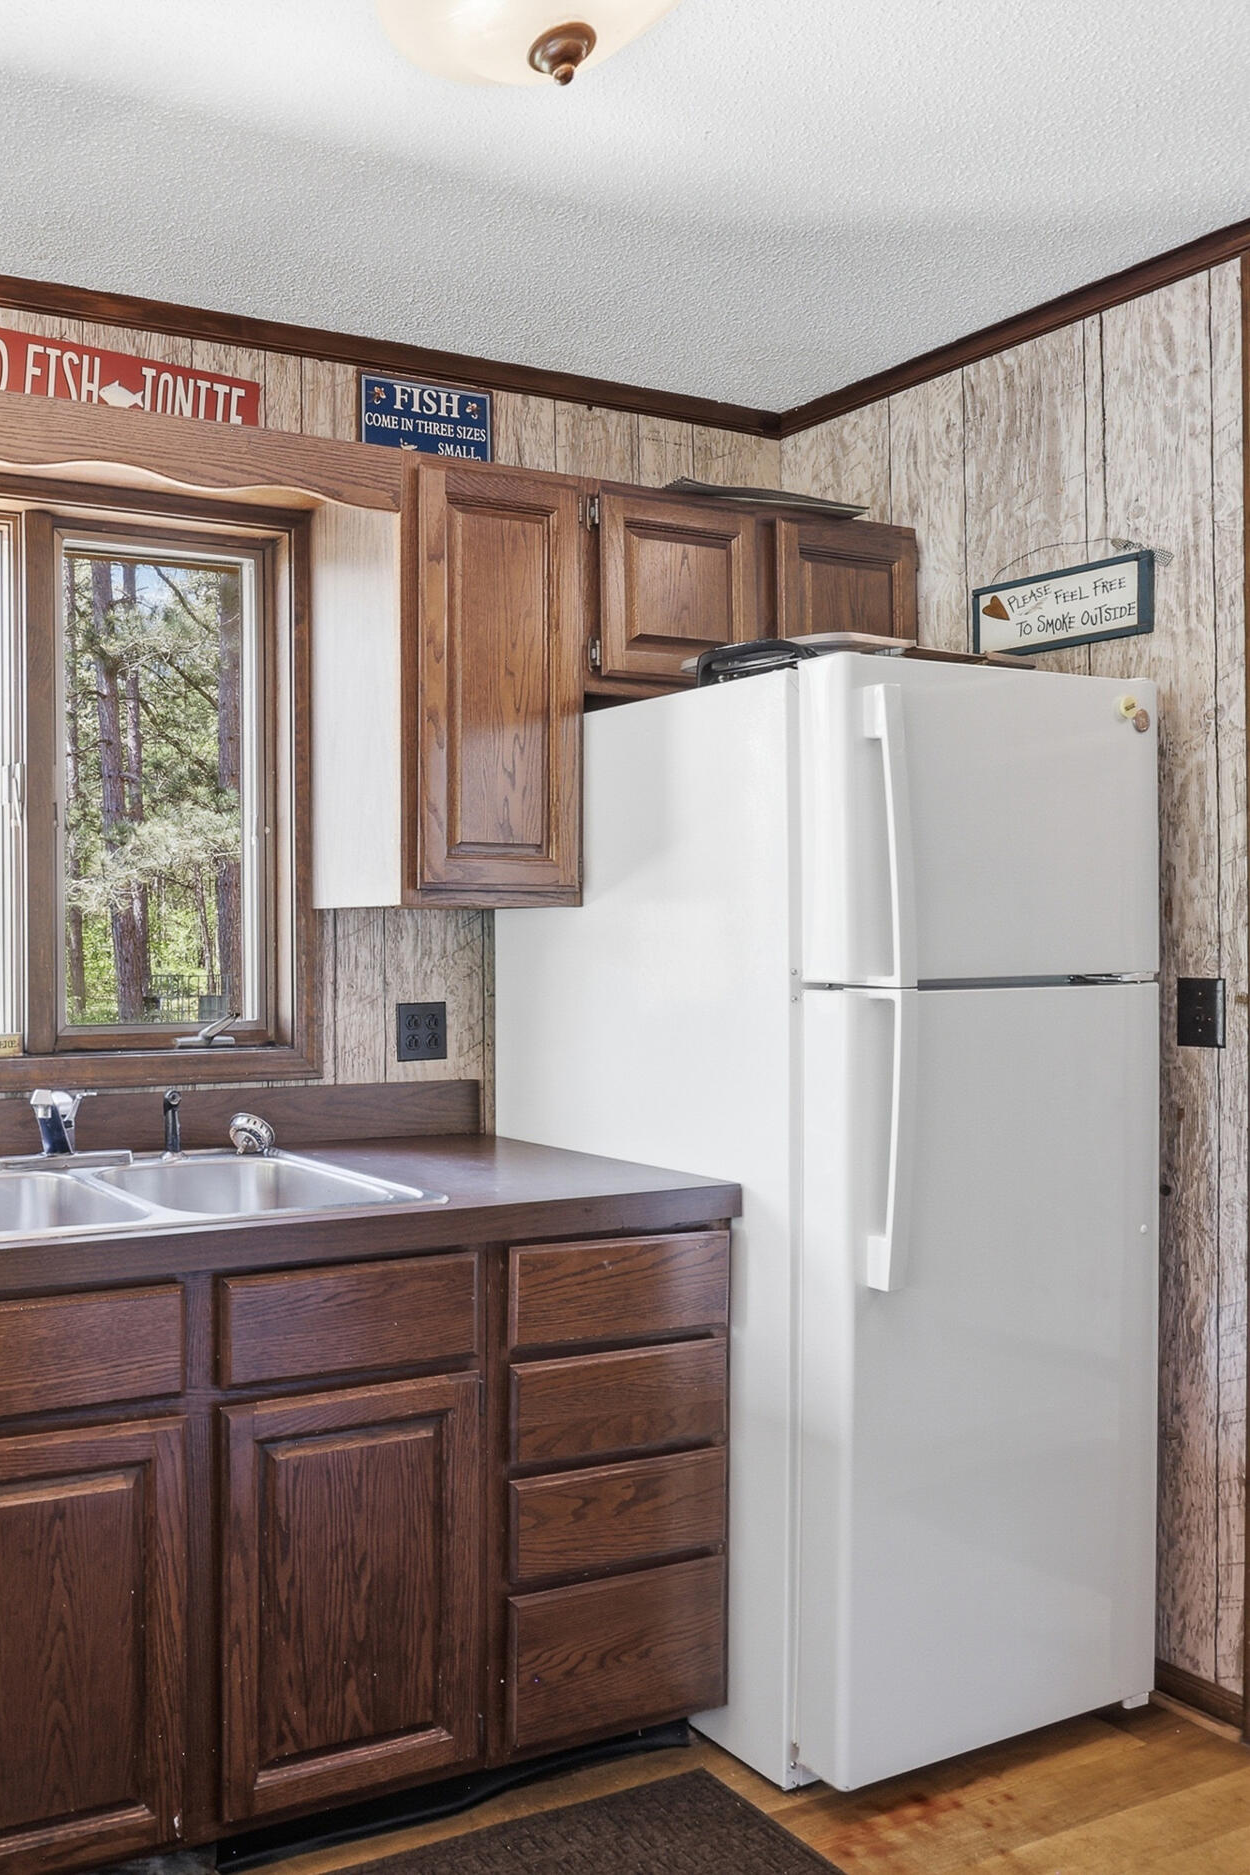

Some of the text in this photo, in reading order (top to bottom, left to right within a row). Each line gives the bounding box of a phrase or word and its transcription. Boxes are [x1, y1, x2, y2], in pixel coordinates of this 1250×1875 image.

[24, 343, 101, 404] FISH
[393, 385, 461, 418] FISH
[364, 412, 487, 442] COME IN THREE SIZES
[1006, 576, 1127, 613] PLEASE FEEL FREE
[1016, 619, 1033, 637] TO
[1037, 612, 1076, 635] SMOKE
